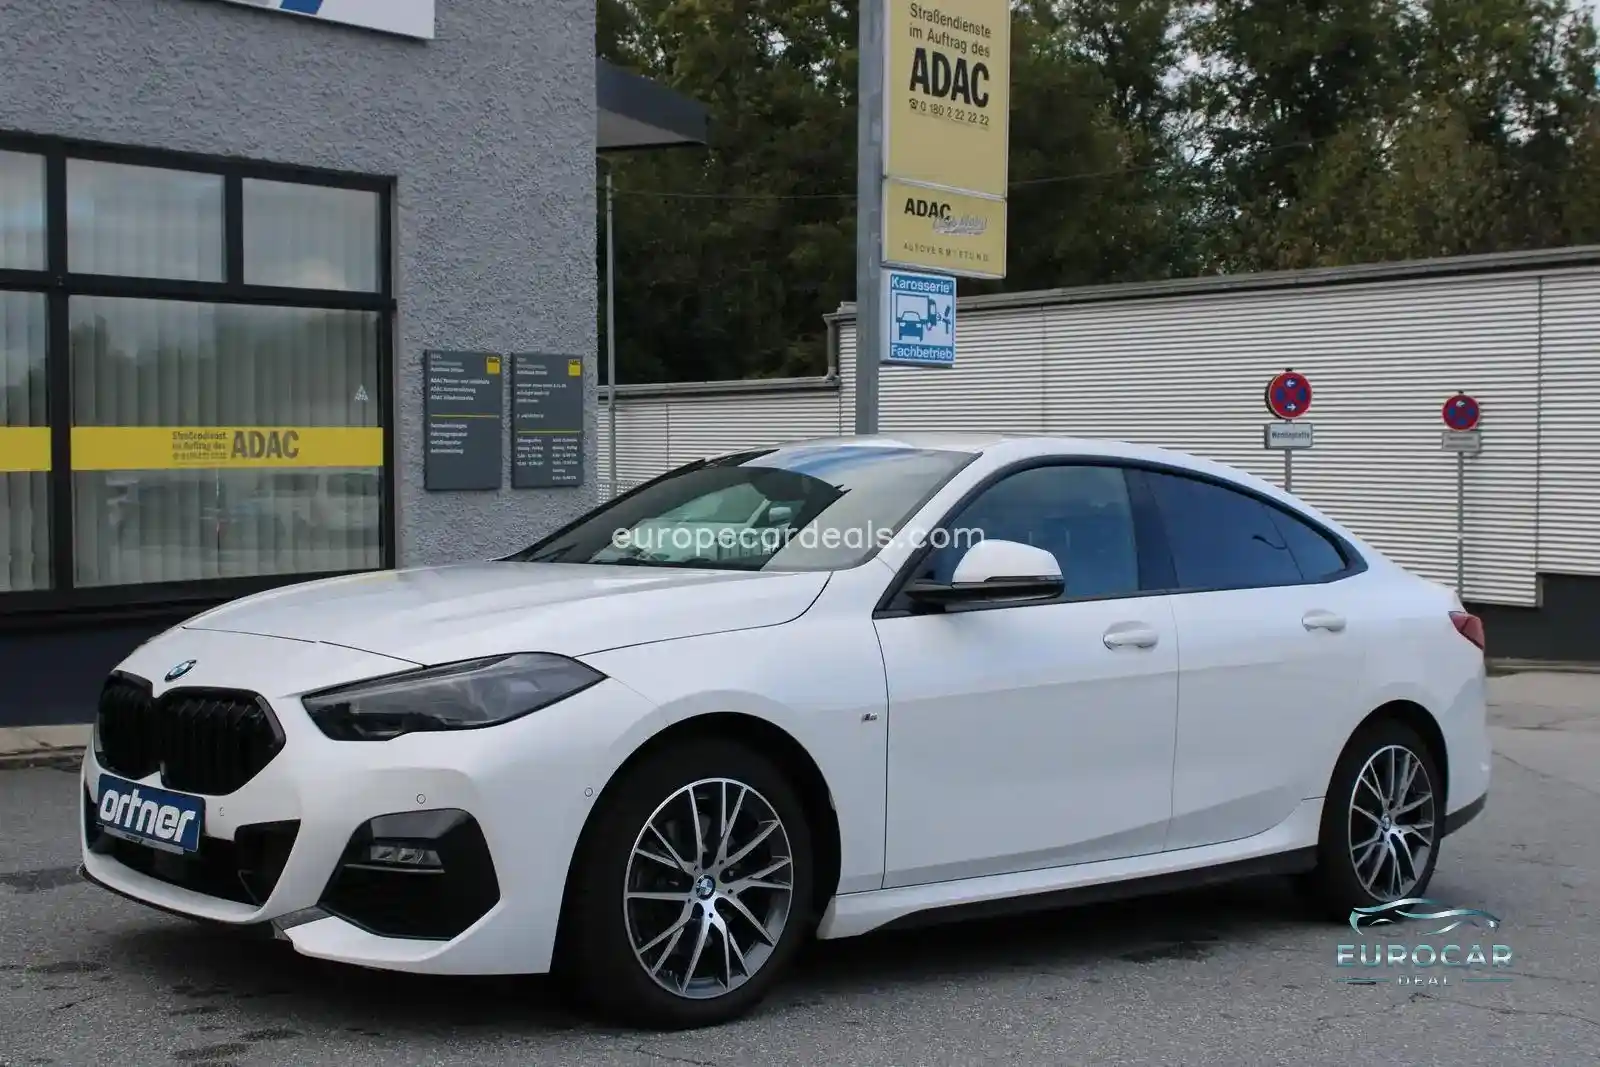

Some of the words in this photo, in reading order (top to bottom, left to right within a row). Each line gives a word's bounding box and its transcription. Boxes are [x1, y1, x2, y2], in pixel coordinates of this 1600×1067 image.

[909, 3, 991, 38] Straßendienste
[909, 22, 923, 39] im
[927, 29, 968, 54] Auftrag
[971, 41, 990, 58] des
[909, 47, 990, 108] ADAC
[920, 101, 927, 112] 0
[929, 103, 945, 116] 180
[954, 110, 965, 121] 22
[968, 112, 977, 124] 22
[980, 114, 990, 126] 22
[904, 198, 951, 221] ADAC
[892, 277, 950, 293] Karosserie
[892, 344, 952, 360] Fachbetrieb
[231, 430, 299, 458] ADAC
[99, 788, 196, 842] ortner
